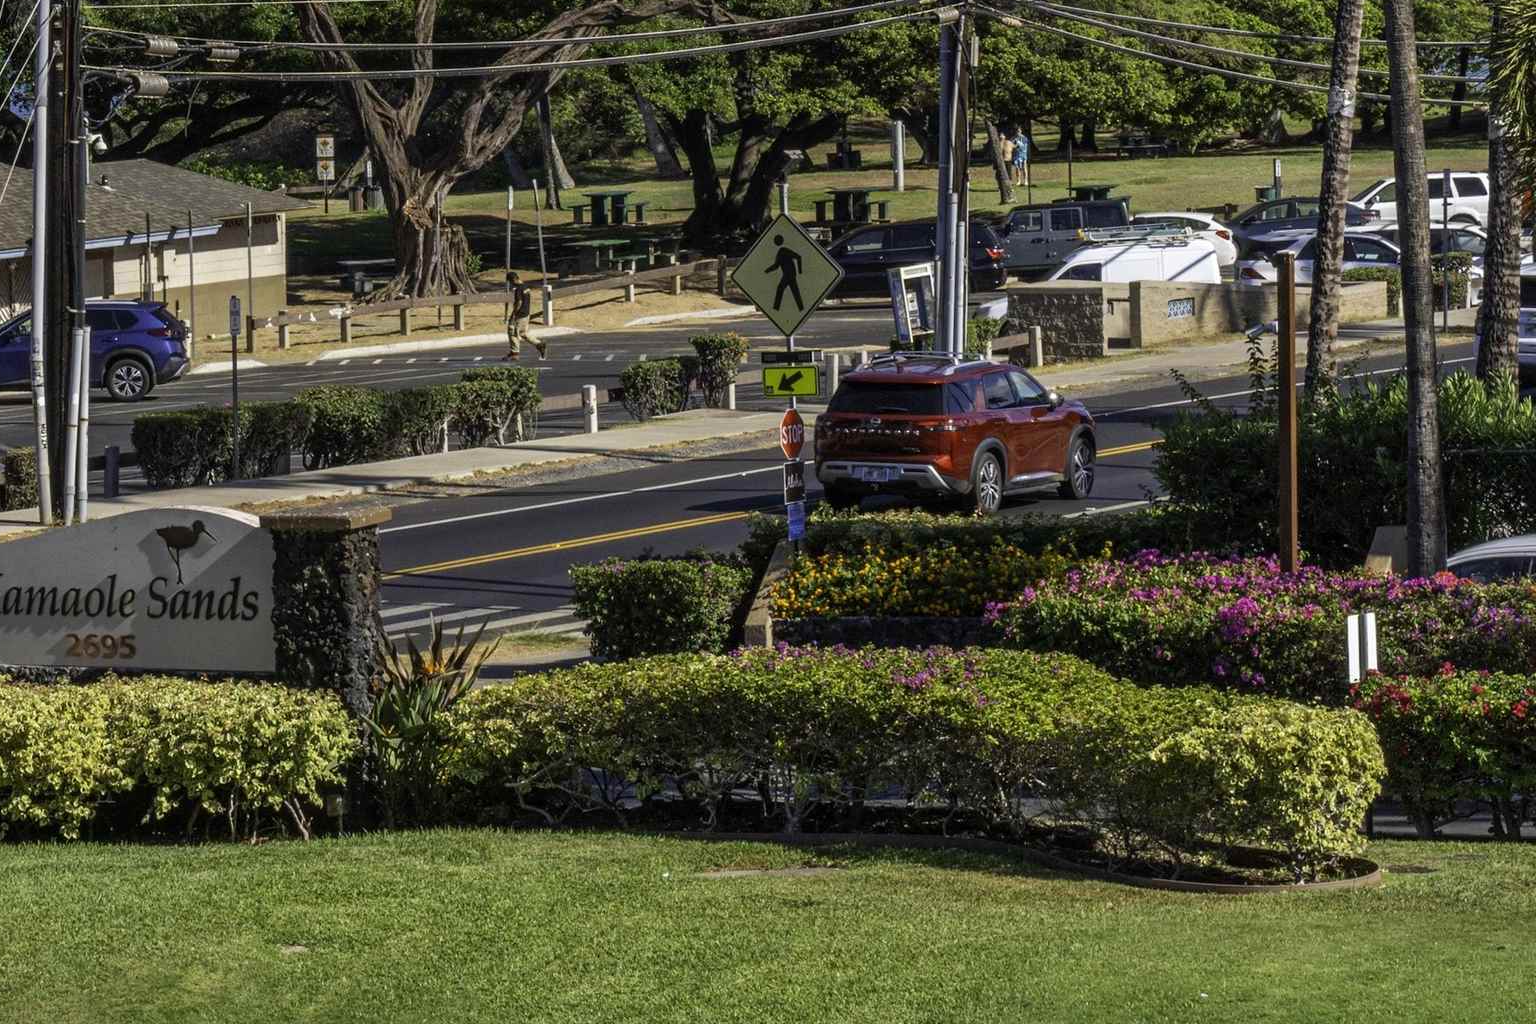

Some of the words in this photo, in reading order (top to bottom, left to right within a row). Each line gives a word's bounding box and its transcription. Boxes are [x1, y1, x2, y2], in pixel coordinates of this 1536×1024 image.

[783, 424, 802, 444] STOP
[146, 576, 260, 621] Sands
[65, 633, 137, 659] 2695
